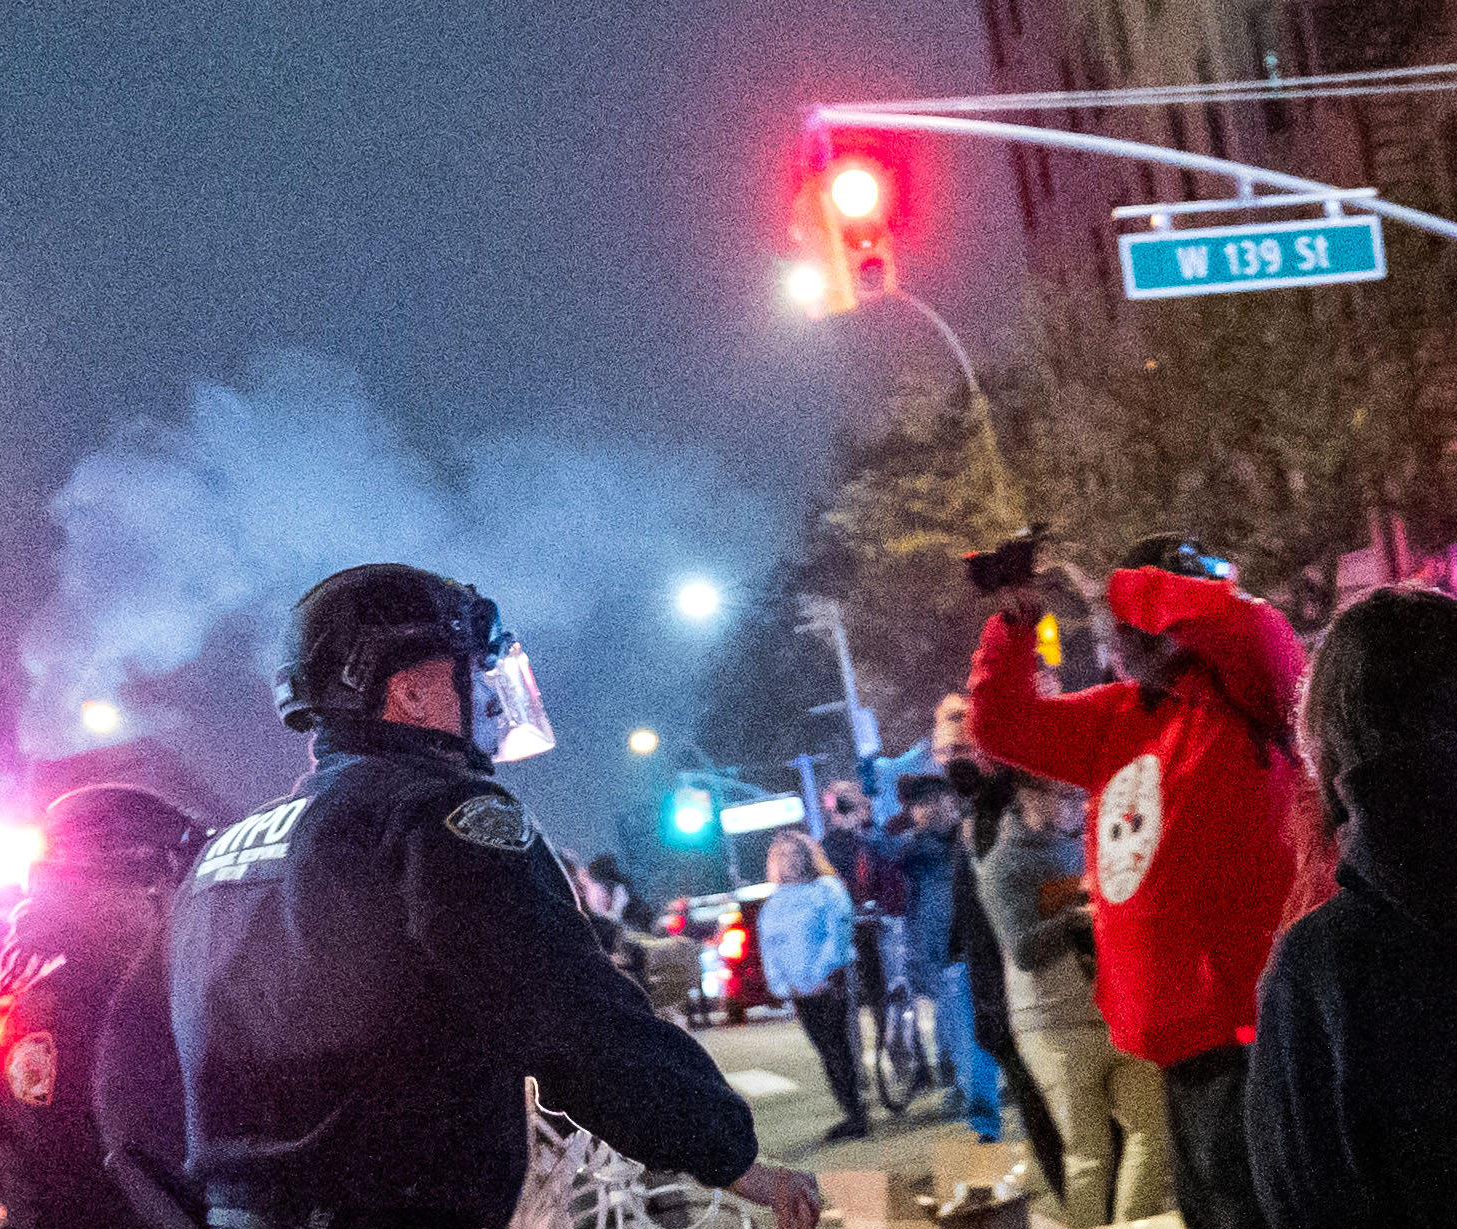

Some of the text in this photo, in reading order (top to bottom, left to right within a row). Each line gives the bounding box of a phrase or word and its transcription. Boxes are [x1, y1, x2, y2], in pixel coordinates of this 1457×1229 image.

[1176, 234, 1331, 280] W 139 St
